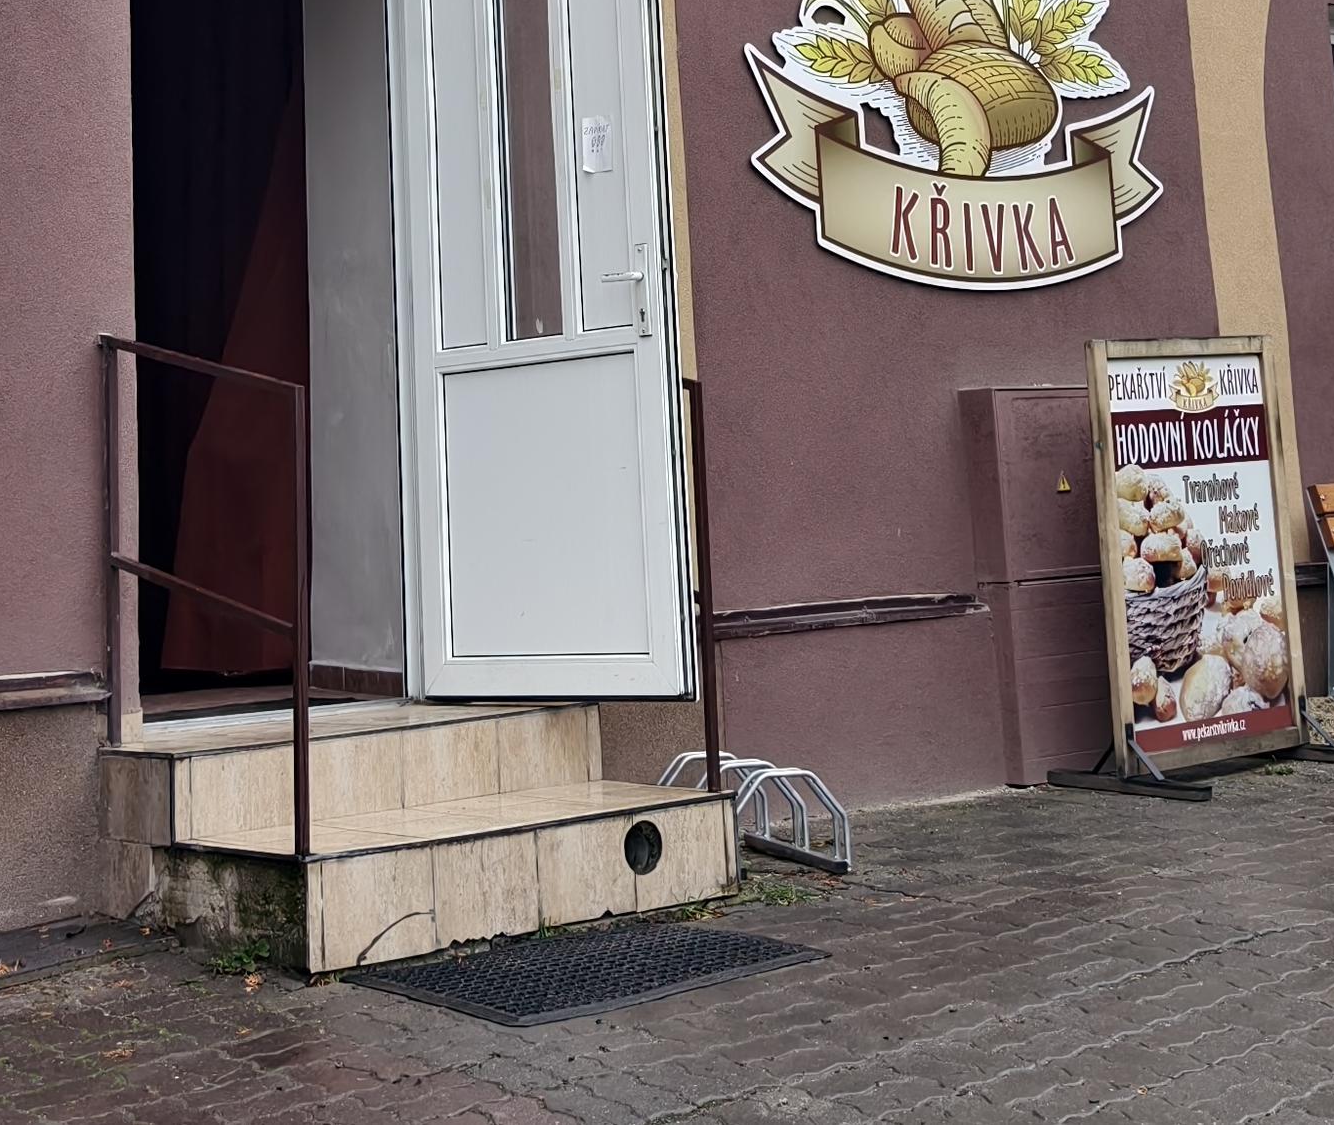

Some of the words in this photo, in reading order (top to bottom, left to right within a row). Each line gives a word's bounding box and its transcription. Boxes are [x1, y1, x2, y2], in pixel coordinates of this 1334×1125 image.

[890, 181, 1076, 275] KŘIVKA
[1107, 366, 1167, 401] PEKAŘSTVÍ
[1218, 363, 1259, 396] KŘIVKA
[1115, 411, 1187, 465] HODOVNÍ
[1191, 409, 1260, 460] KOLÁČKY
[1182, 472, 1240, 504] Tvarohové
[1218, 503, 1260, 535] Makové
[1200, 536, 1250, 570] Ořechové
[1222, 568, 1275, 602] Povidlové
